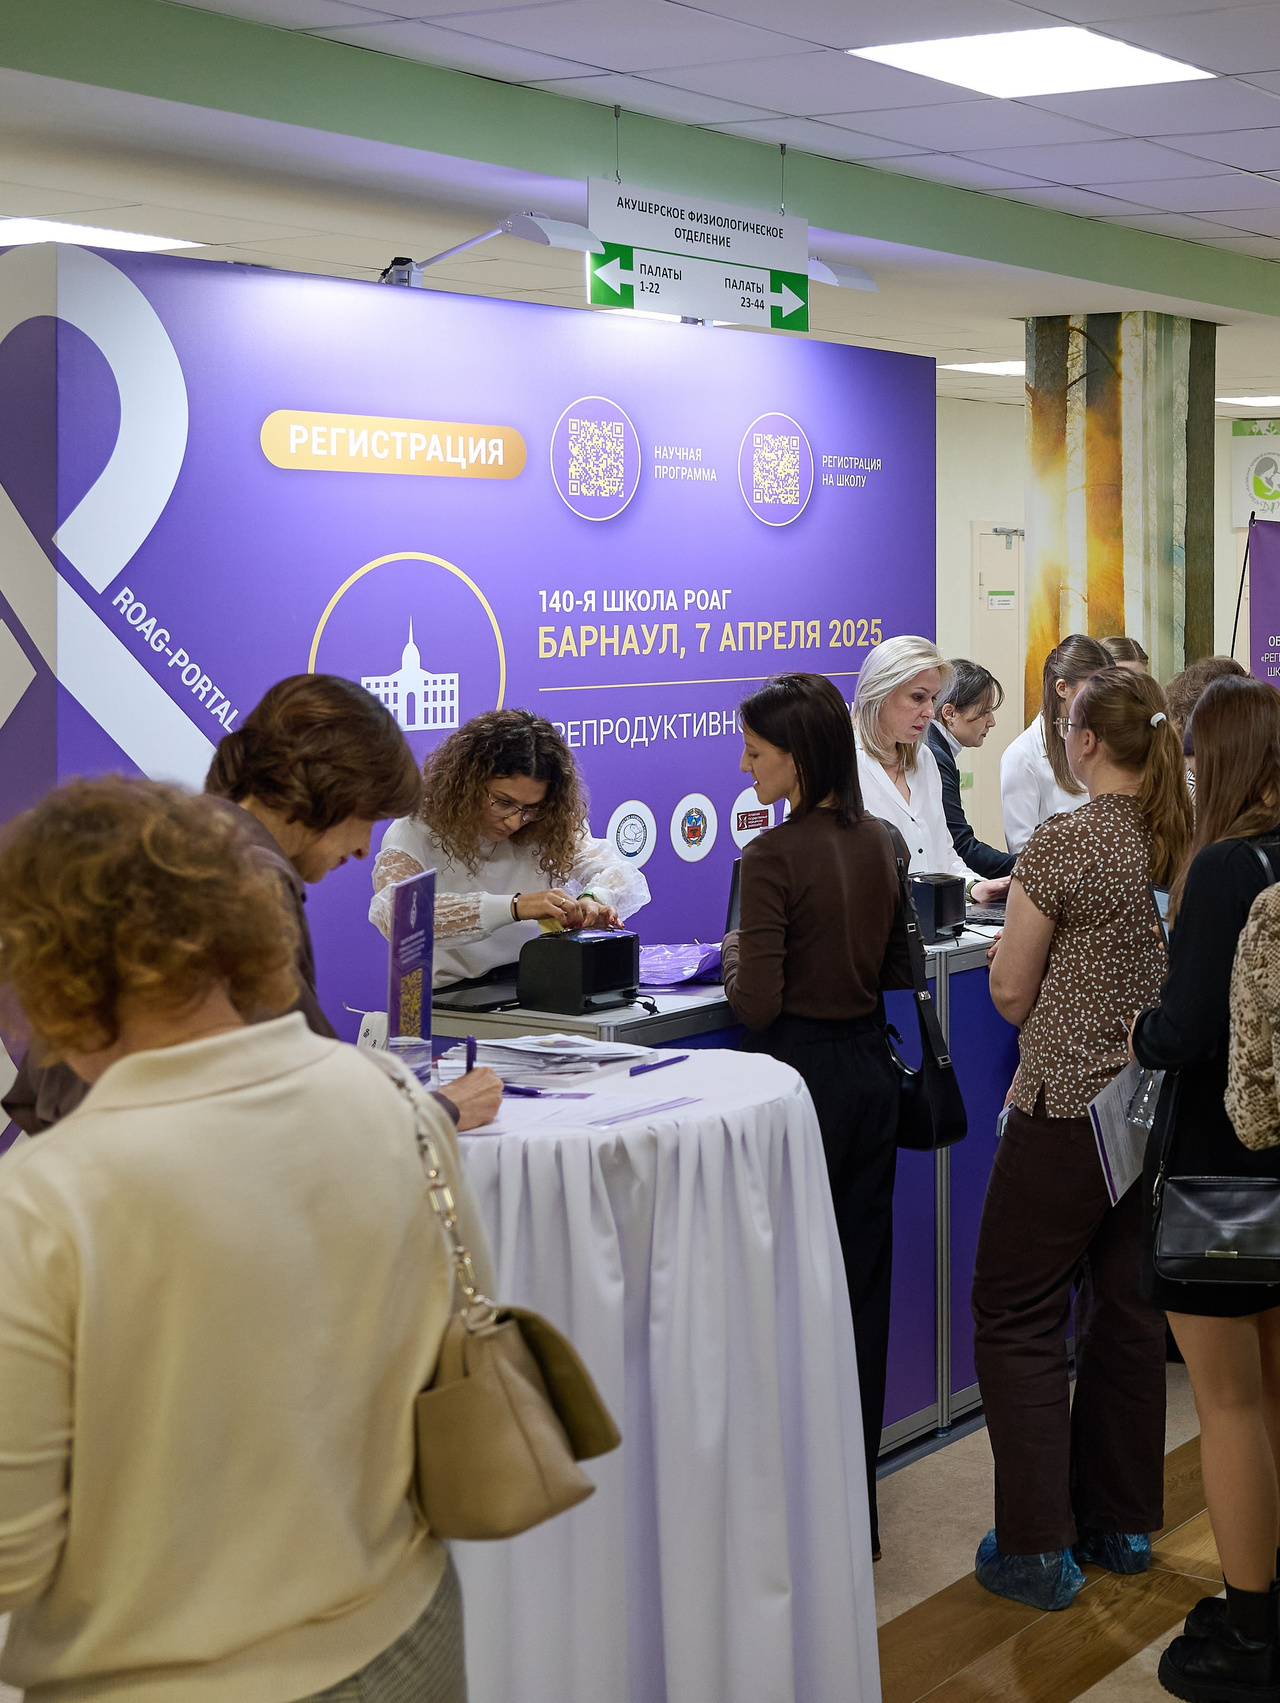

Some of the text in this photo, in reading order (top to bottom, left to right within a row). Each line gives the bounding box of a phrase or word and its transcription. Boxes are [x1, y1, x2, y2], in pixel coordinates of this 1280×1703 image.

[616, 196, 785, 240] АКУШЕРСКОЕ ФИЗИОЛОГИЧЕСКОЕ
[674, 227, 731, 248] ОТДЕЛЕНИЕ
[639, 263, 682, 281] ПАЛАТЫ
[639, 281, 660, 295] 1-22
[724, 277, 764, 295] ПАЛАТЫ
[740, 296, 765, 310] 23-44
[289, 424, 504, 468] РЕГИСТРАЦИЯ
[654, 445, 702, 462] НАУЧНАЯ
[822, 454, 882, 472] РЕГИСТРАЦИЯ
[654, 464, 718, 483] ПРОГРАММА
[822, 473, 867, 489] НА ШКОЛУ
[538, 589, 732, 612] 140-Я ШКОЛА РОАГ
[538, 617, 883, 660] БАРНАУЛ, 7 АПРЕЛЯ 2025
[112, 586, 239, 733] ROAG-PORTAL
